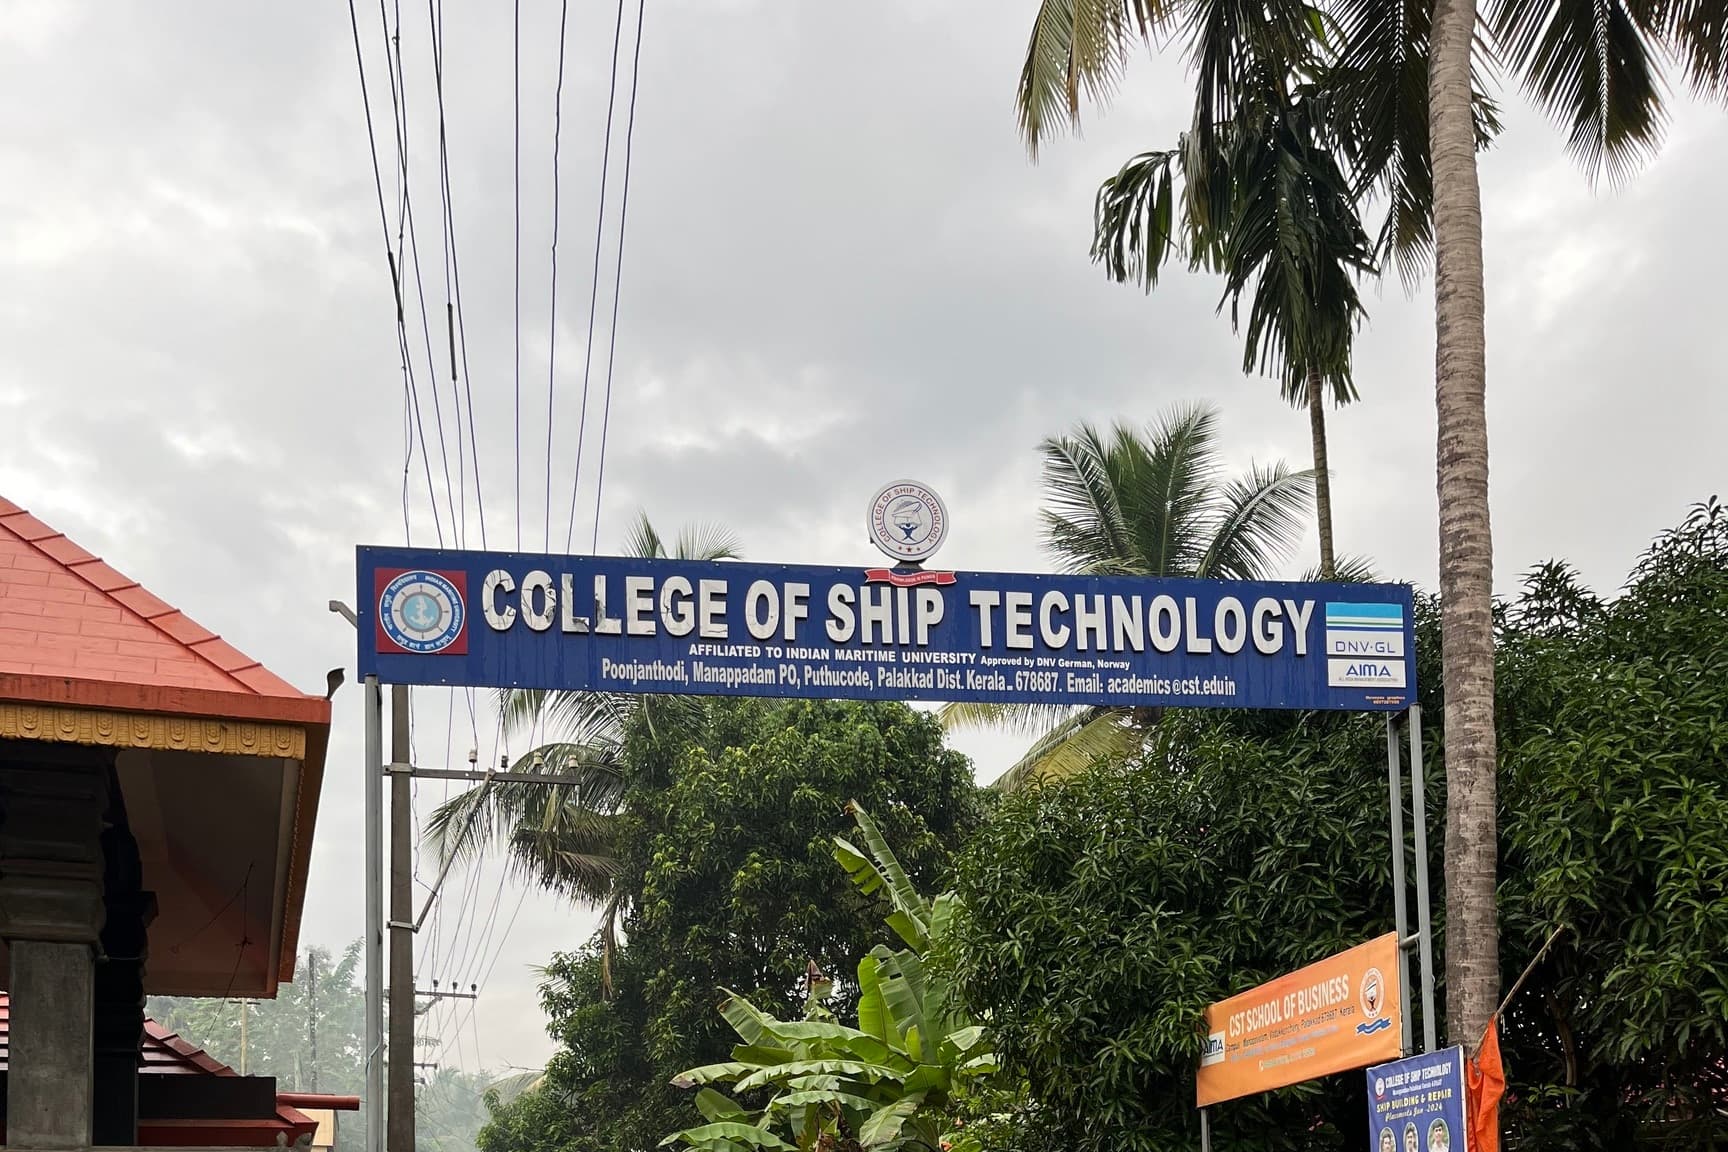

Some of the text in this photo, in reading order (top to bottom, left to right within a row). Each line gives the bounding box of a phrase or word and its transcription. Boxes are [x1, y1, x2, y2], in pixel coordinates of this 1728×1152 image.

[874, 503, 890, 543] COLLEGE
[894, 487, 915, 496] SHIP
[917, 490, 941, 544] TECHNOLOGY
[482, 569, 729, 638] COLLEGE
[745, 579, 810, 641] OF
[825, 583, 945, 645] SHIP
[969, 590, 1316, 655] TECHNOLOGY
[689, 643, 1130, 670] AFFILIATED TO INDIAN MARITIME UNIVERSITY Approved by DNV German, Norway
[1346, 664, 1392, 677] AIMA
[602, 658, 689, 686] Poonjanthodi,
[693, 661, 776, 688] Manappadam
[779, 663, 801, 689] PO,
[804, 665, 873, 691] Puthucode,
[878, 667, 934, 689] Palakkad
[937, 669, 964, 690] Dist.
[1067, 673, 1104, 694] Email:
[1229, 1011, 1245, 1038] CST
[1246, 1000, 1282, 1033] SCHOOL
[1283, 993, 1296, 1020] OF
[1299, 974, 1350, 1016] BUSINESS
[1385, 1074, 1404, 1088] COLLEGE
[1411, 1070, 1421, 1082] SHIP
[1422, 1062, 1452, 1080] TECHNOLOGY
[1376, 1088, 1452, 1113] SHIP BUILDING & REPAIR
